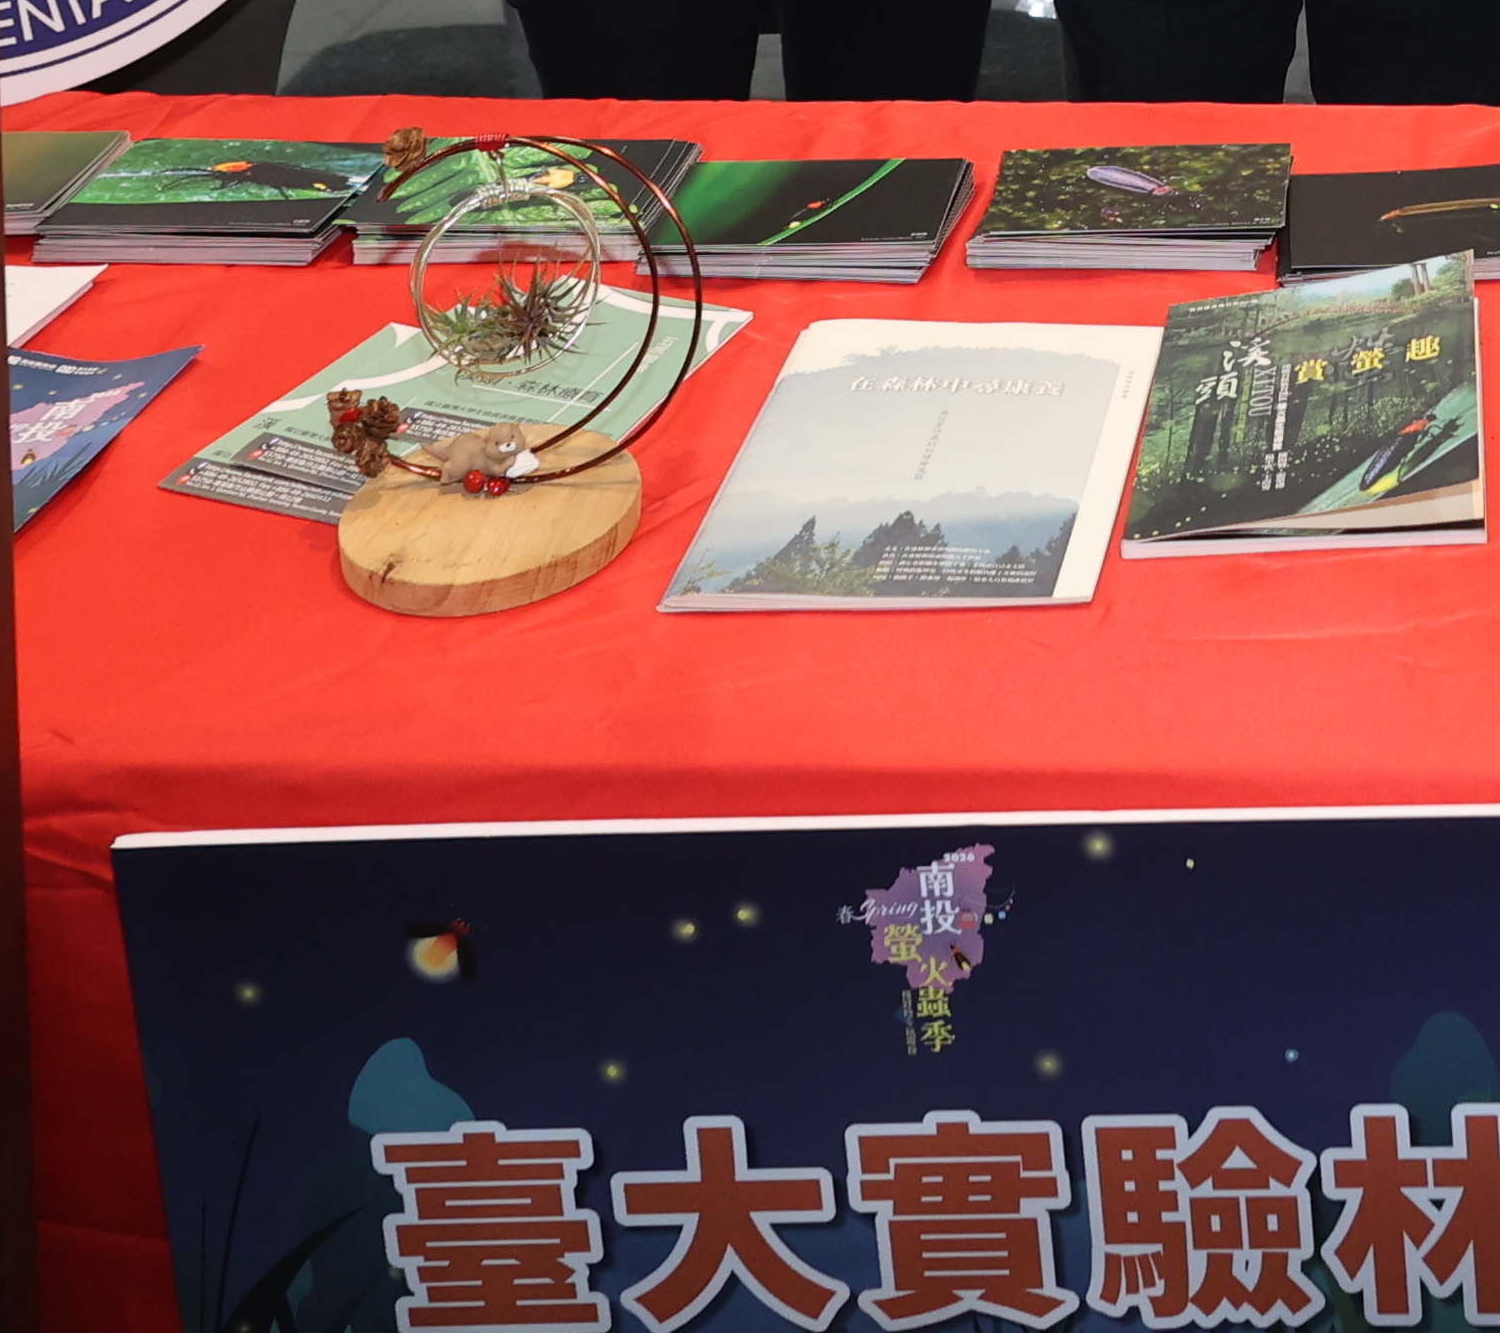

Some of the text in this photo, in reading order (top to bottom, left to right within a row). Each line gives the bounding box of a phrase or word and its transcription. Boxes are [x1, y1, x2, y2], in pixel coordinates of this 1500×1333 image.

[1194, 336, 1273, 405] 溪頭
[1294, 334, 1442, 385] 賞螢趣
[943, 852, 975, 863] 2026
[916, 860, 963, 936] 南投
[883, 923, 956, 1054] 螢火蟲季
